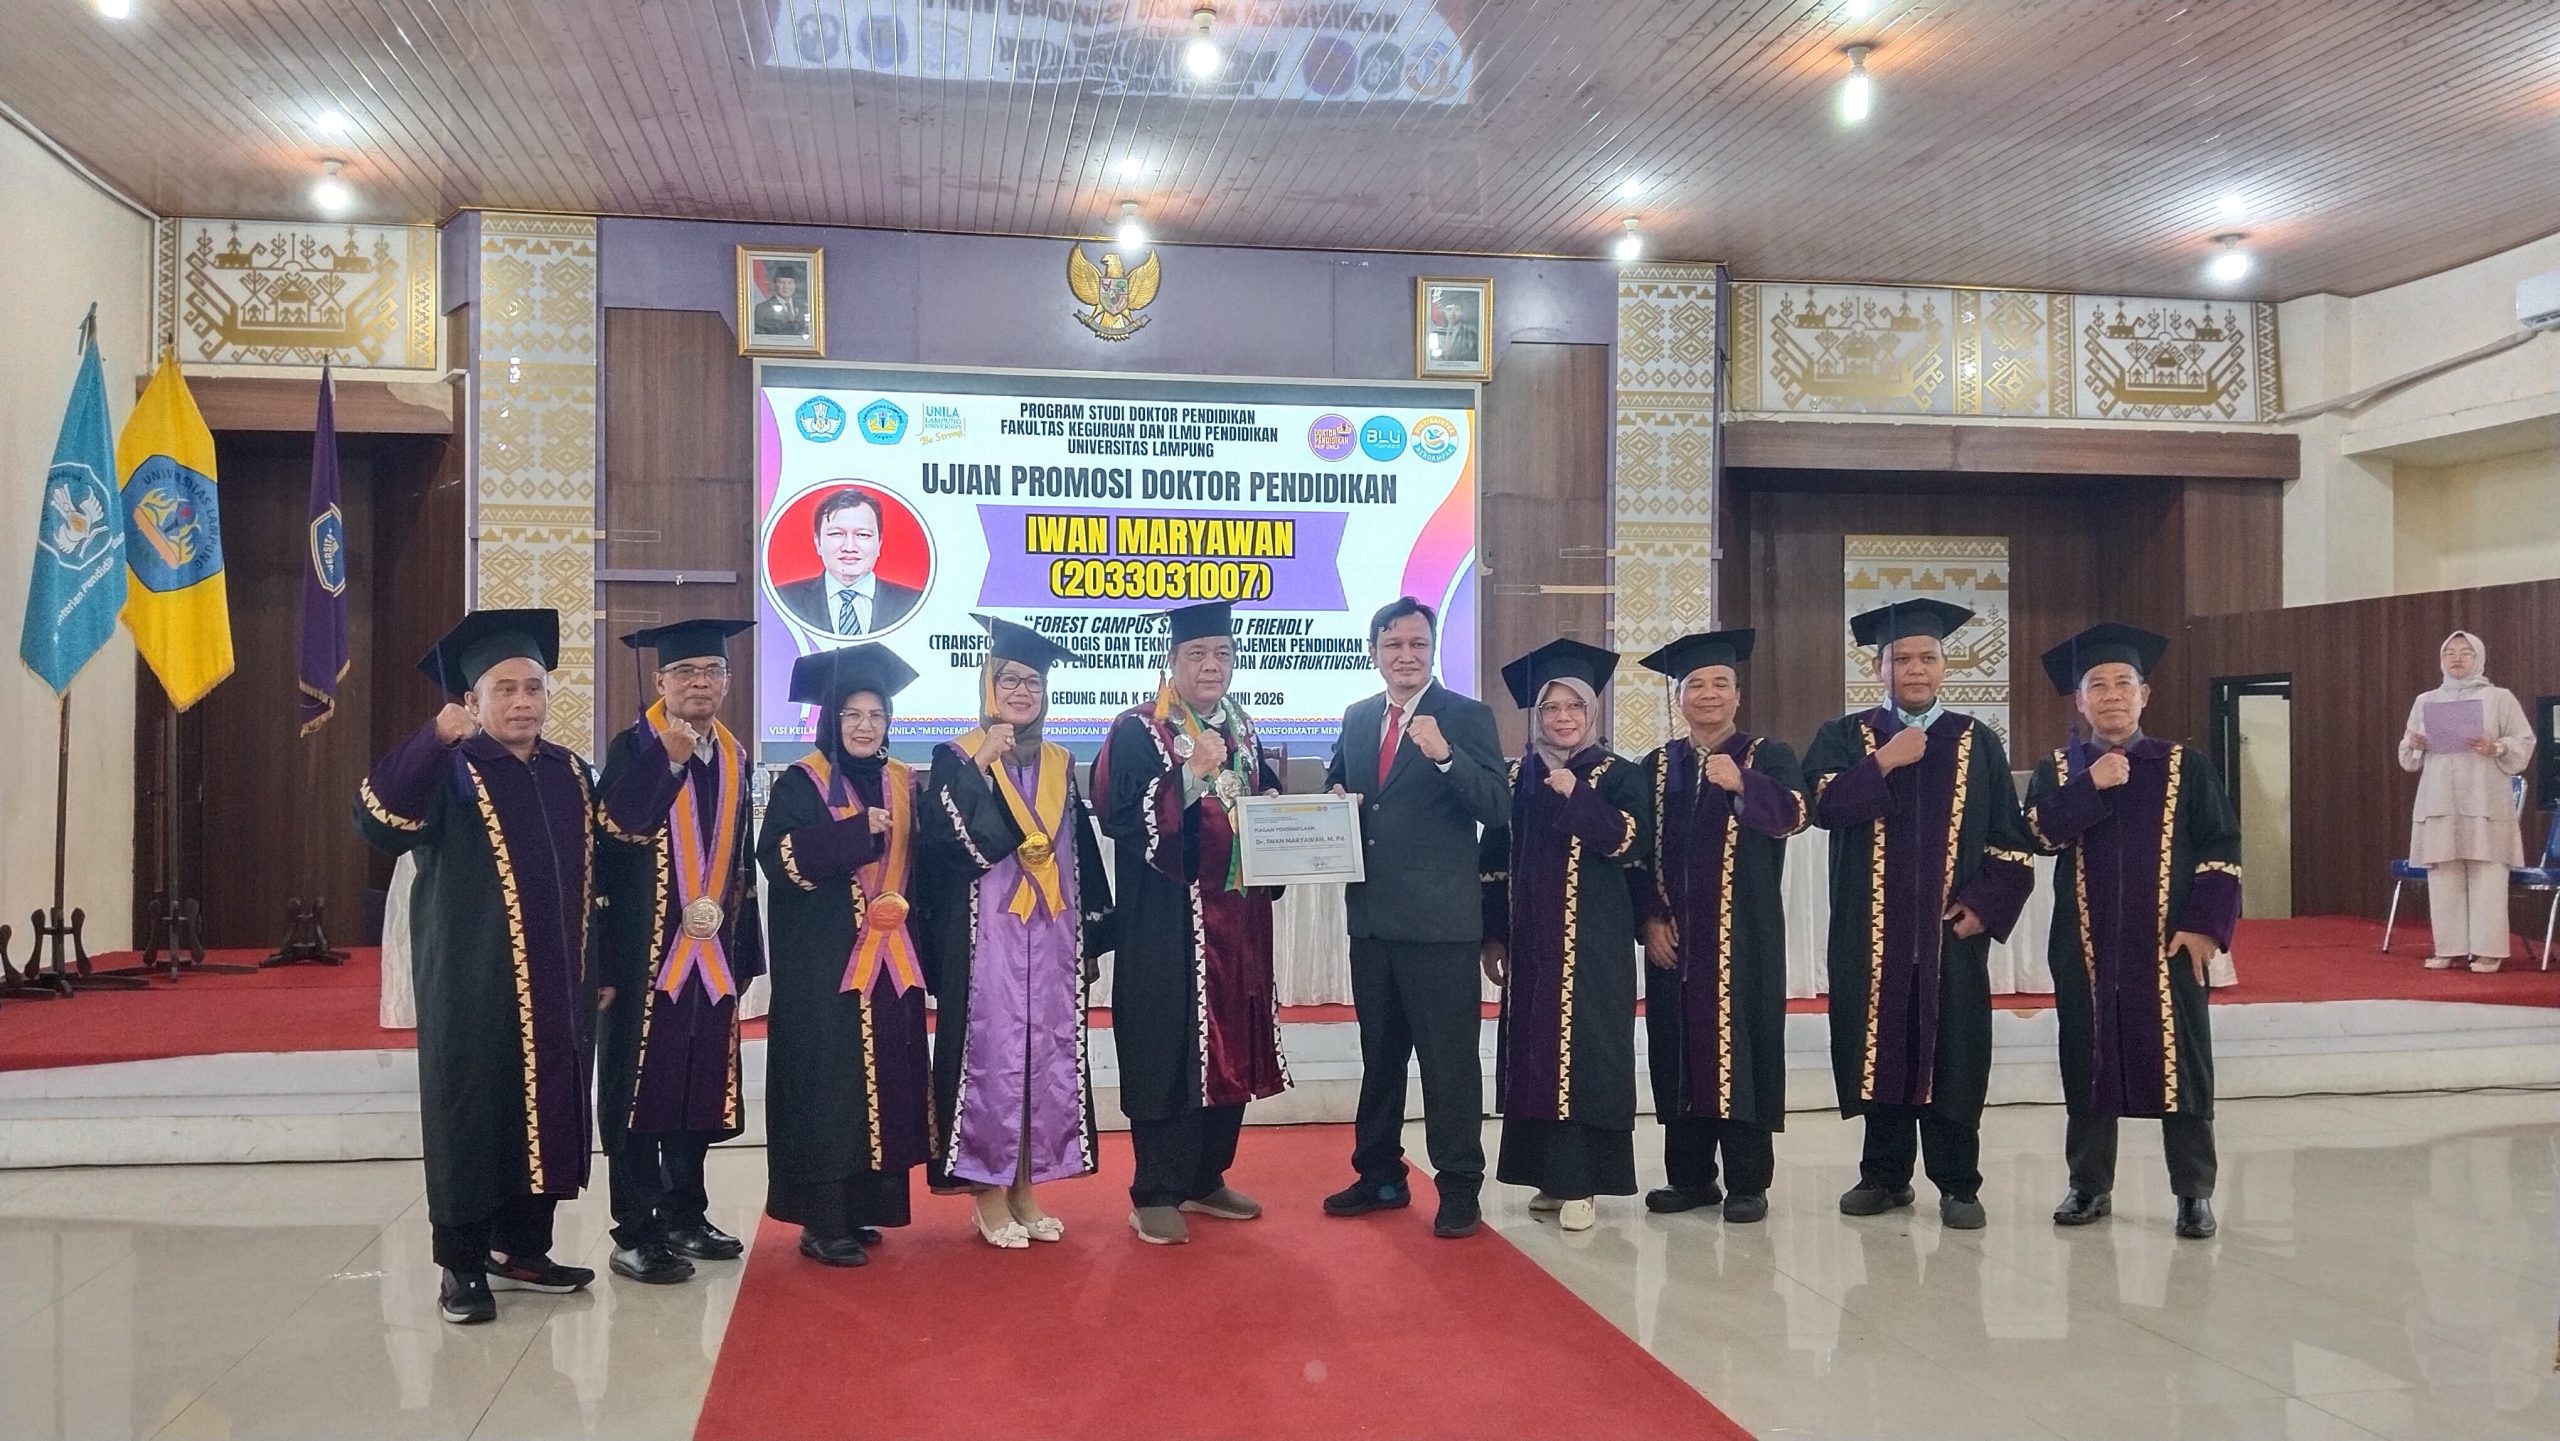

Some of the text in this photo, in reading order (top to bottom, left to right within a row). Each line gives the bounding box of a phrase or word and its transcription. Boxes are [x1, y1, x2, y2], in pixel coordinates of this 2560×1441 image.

[926, 405, 960, 418] UNILA
[1020, 402, 1255, 425] PROGRAM STUDI DOKTOR PENDIDIKAN
[1001, 420, 1278, 442] FAKULTAS KEGURUAN DAN ILMU PENDIDIKAN
[1366, 429, 1401, 444] BLU
[1068, 440, 1213, 458] UNIVERSITAS LAMPUNG
[922, 462, 1397, 504] UJIAN PROMOSI DOKTOR PENDIDIKAN
[193, 508, 219, 570] LAMPUNG
[1027, 515, 1295, 558] IWAN MARYAWAN
[1050, 559, 1272, 600] (2033031007)
[1091, 617, 1154, 635] CAMPUS
[1246, 618, 1314, 636] FRIENDLY
[929, 634, 990, 651] (TRANSFO
[1105, 636, 1130, 652] DAN
[1235, 638, 1286, 653] AJEMEN
[1290, 638, 1363, 654] PENDIDIKAN
[1051, 691, 1097, 705] GEDUNG
[1100, 691, 1129, 705] AULA
[1132, 692, 1140, 705] K
[1230, 692, 1251, 706] UNI
[1254, 691, 1284, 706] 2026
[769, 726, 787, 735] VISI
[789, 726, 816, 735] KEILM
[888, 726, 916, 735] UNILA
[1255, 726, 1319, 735] RANSFORMATIF
